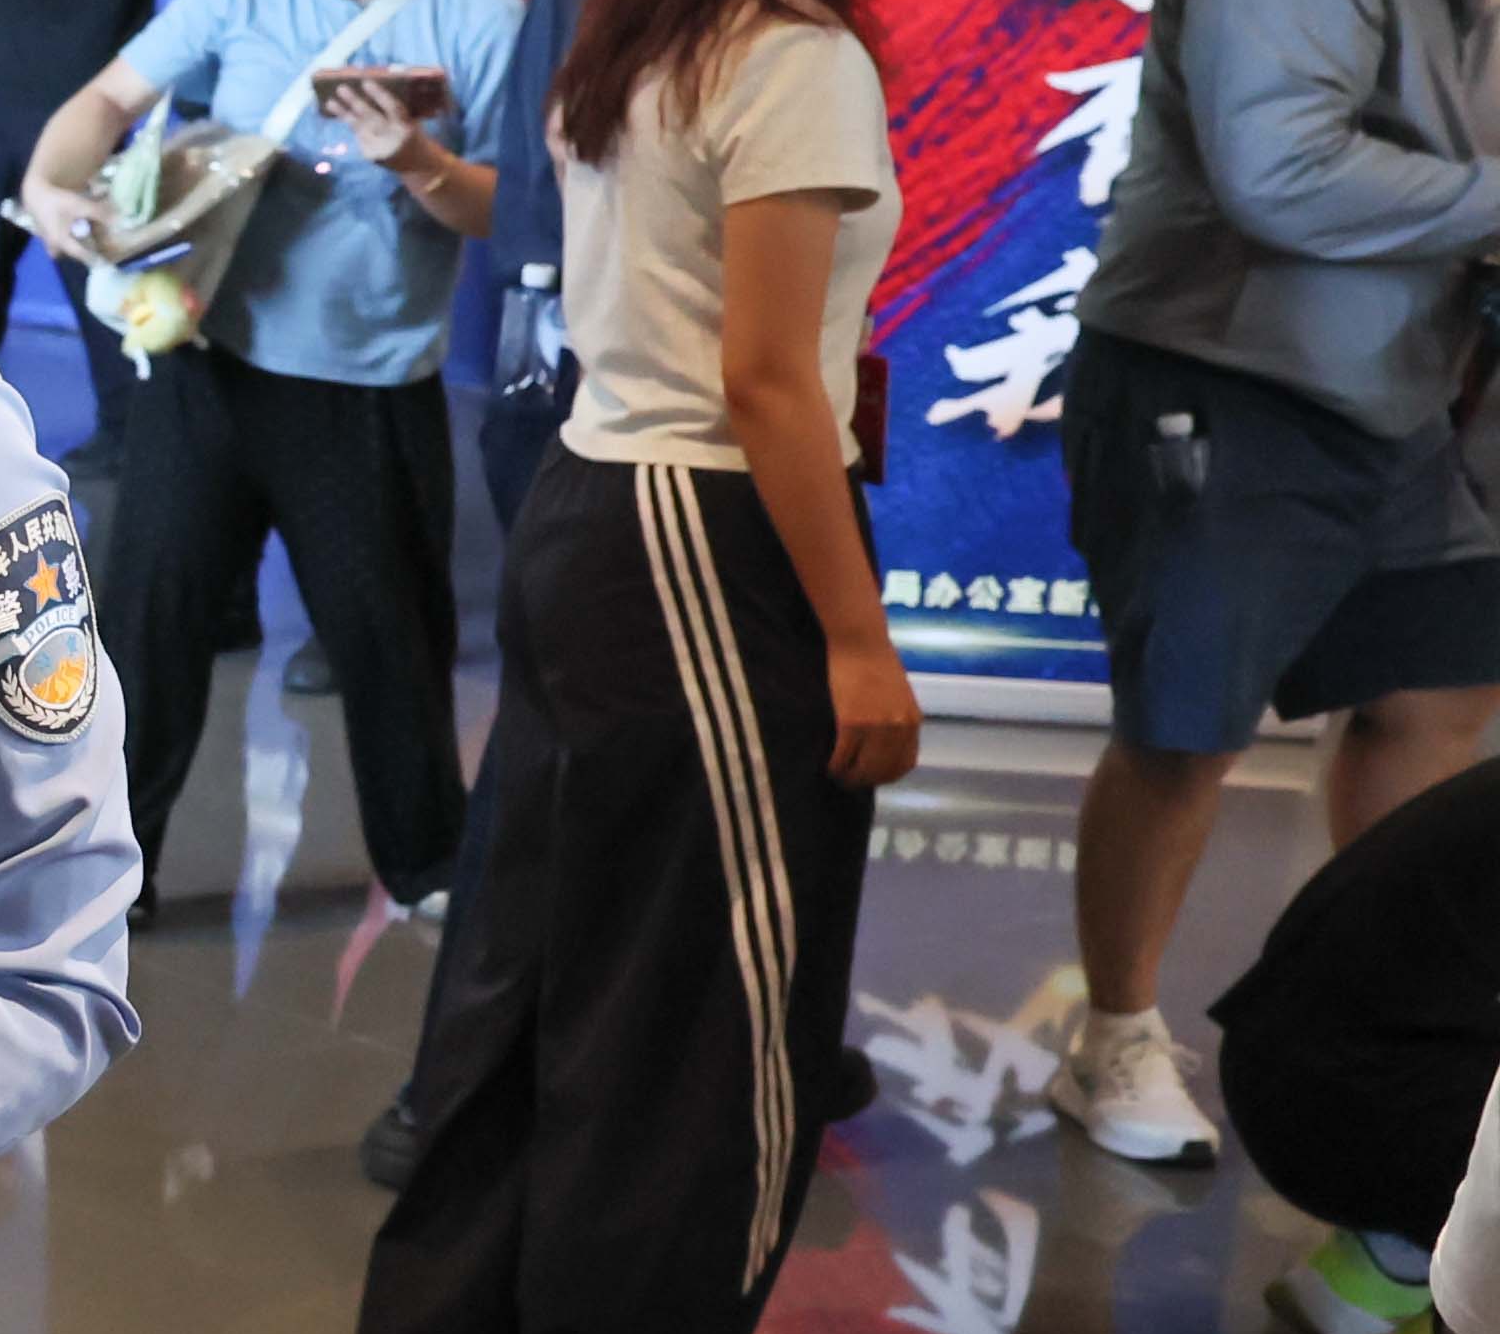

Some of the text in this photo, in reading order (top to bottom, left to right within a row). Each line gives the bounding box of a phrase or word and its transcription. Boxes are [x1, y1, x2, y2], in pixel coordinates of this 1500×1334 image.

[881, 568, 1100, 617] 局办公室新
[24, 606, 77, 646] POLICE
